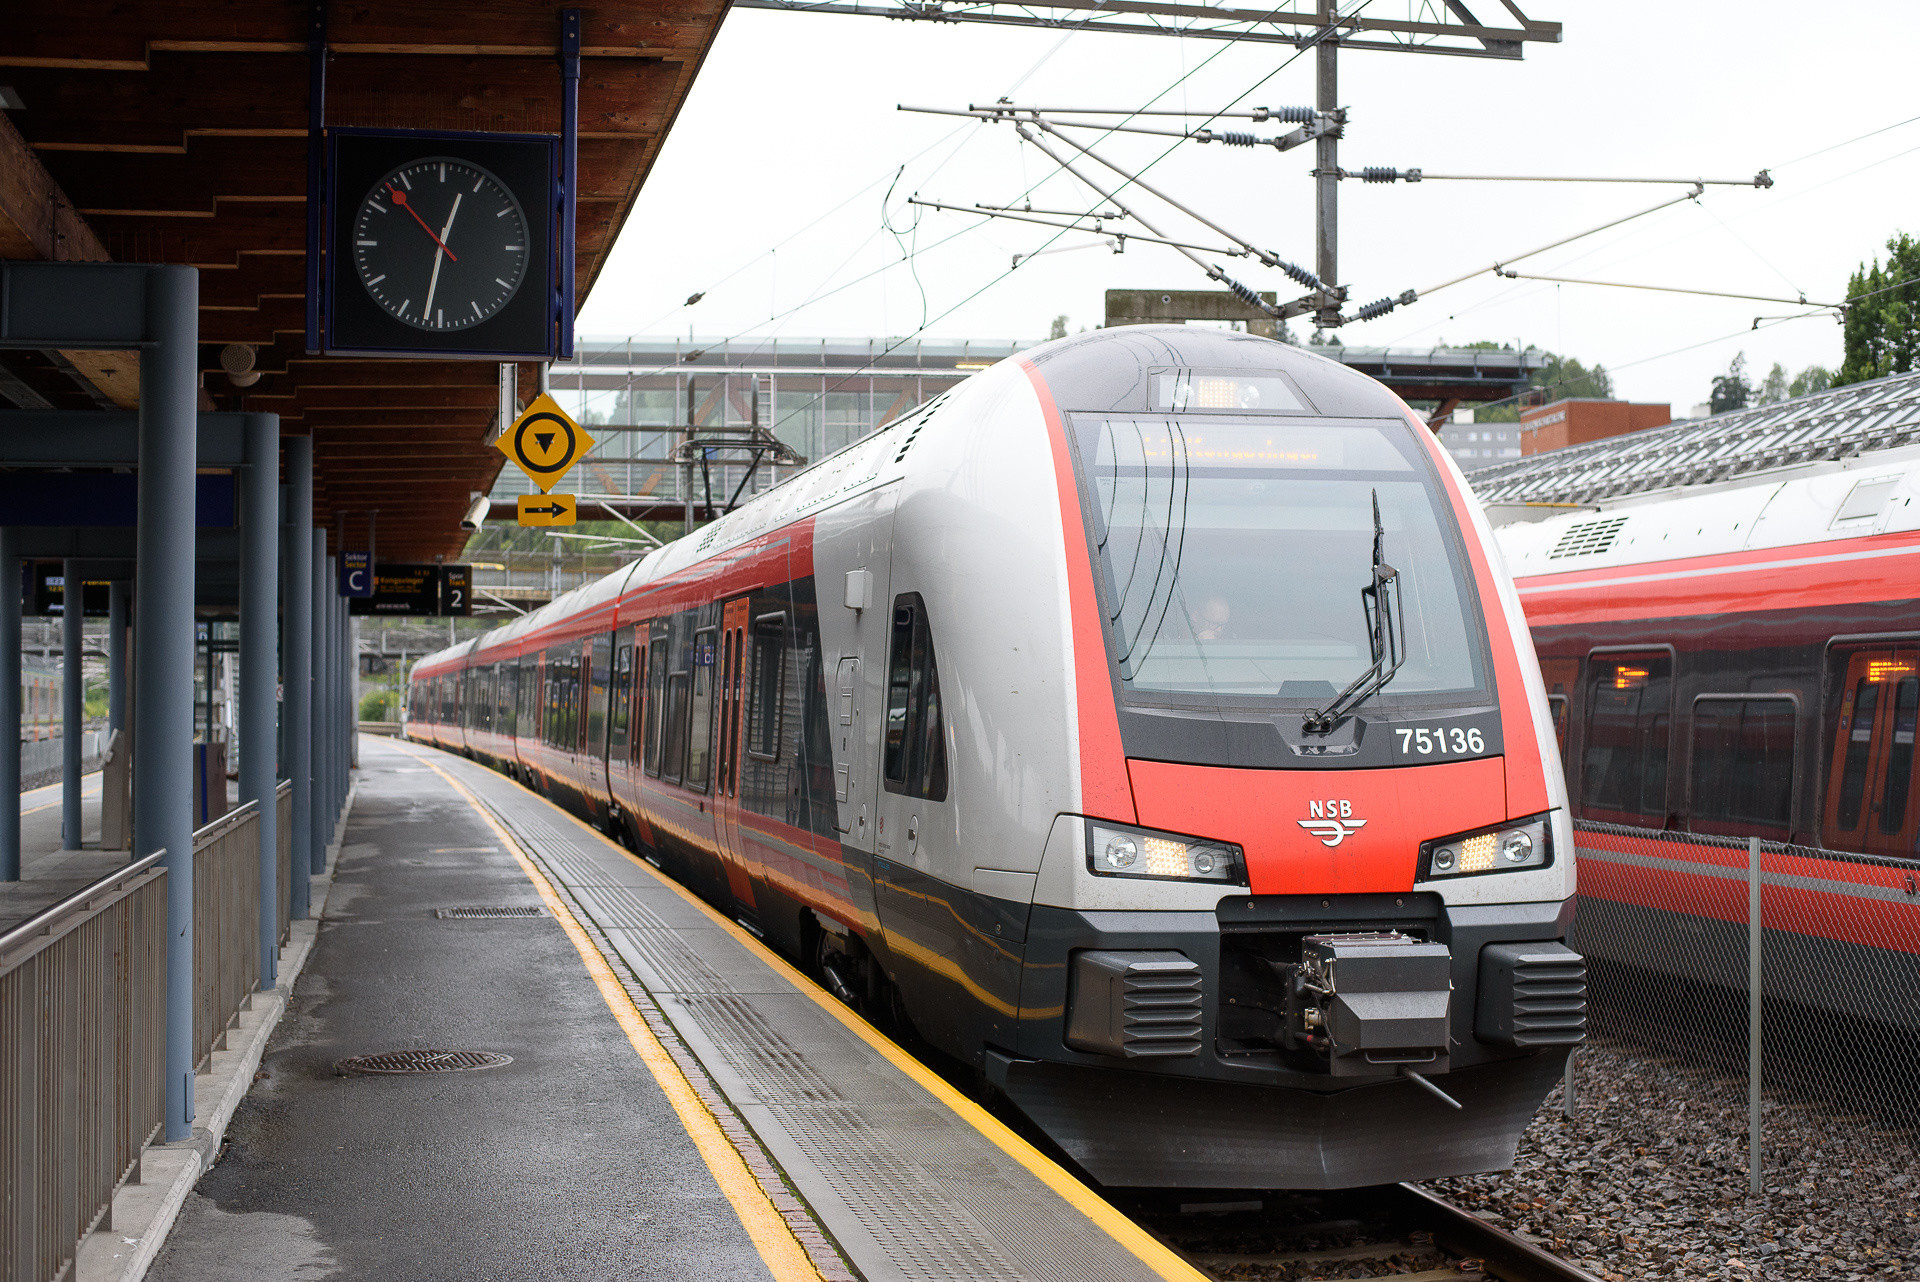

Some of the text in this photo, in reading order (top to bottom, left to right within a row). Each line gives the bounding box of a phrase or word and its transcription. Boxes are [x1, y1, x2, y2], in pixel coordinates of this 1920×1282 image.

[348, 570, 364, 591] C
[450, 589, 463, 607] 2
[1395, 727, 1486, 754] 75136
[1309, 799, 1354, 818] NSB
